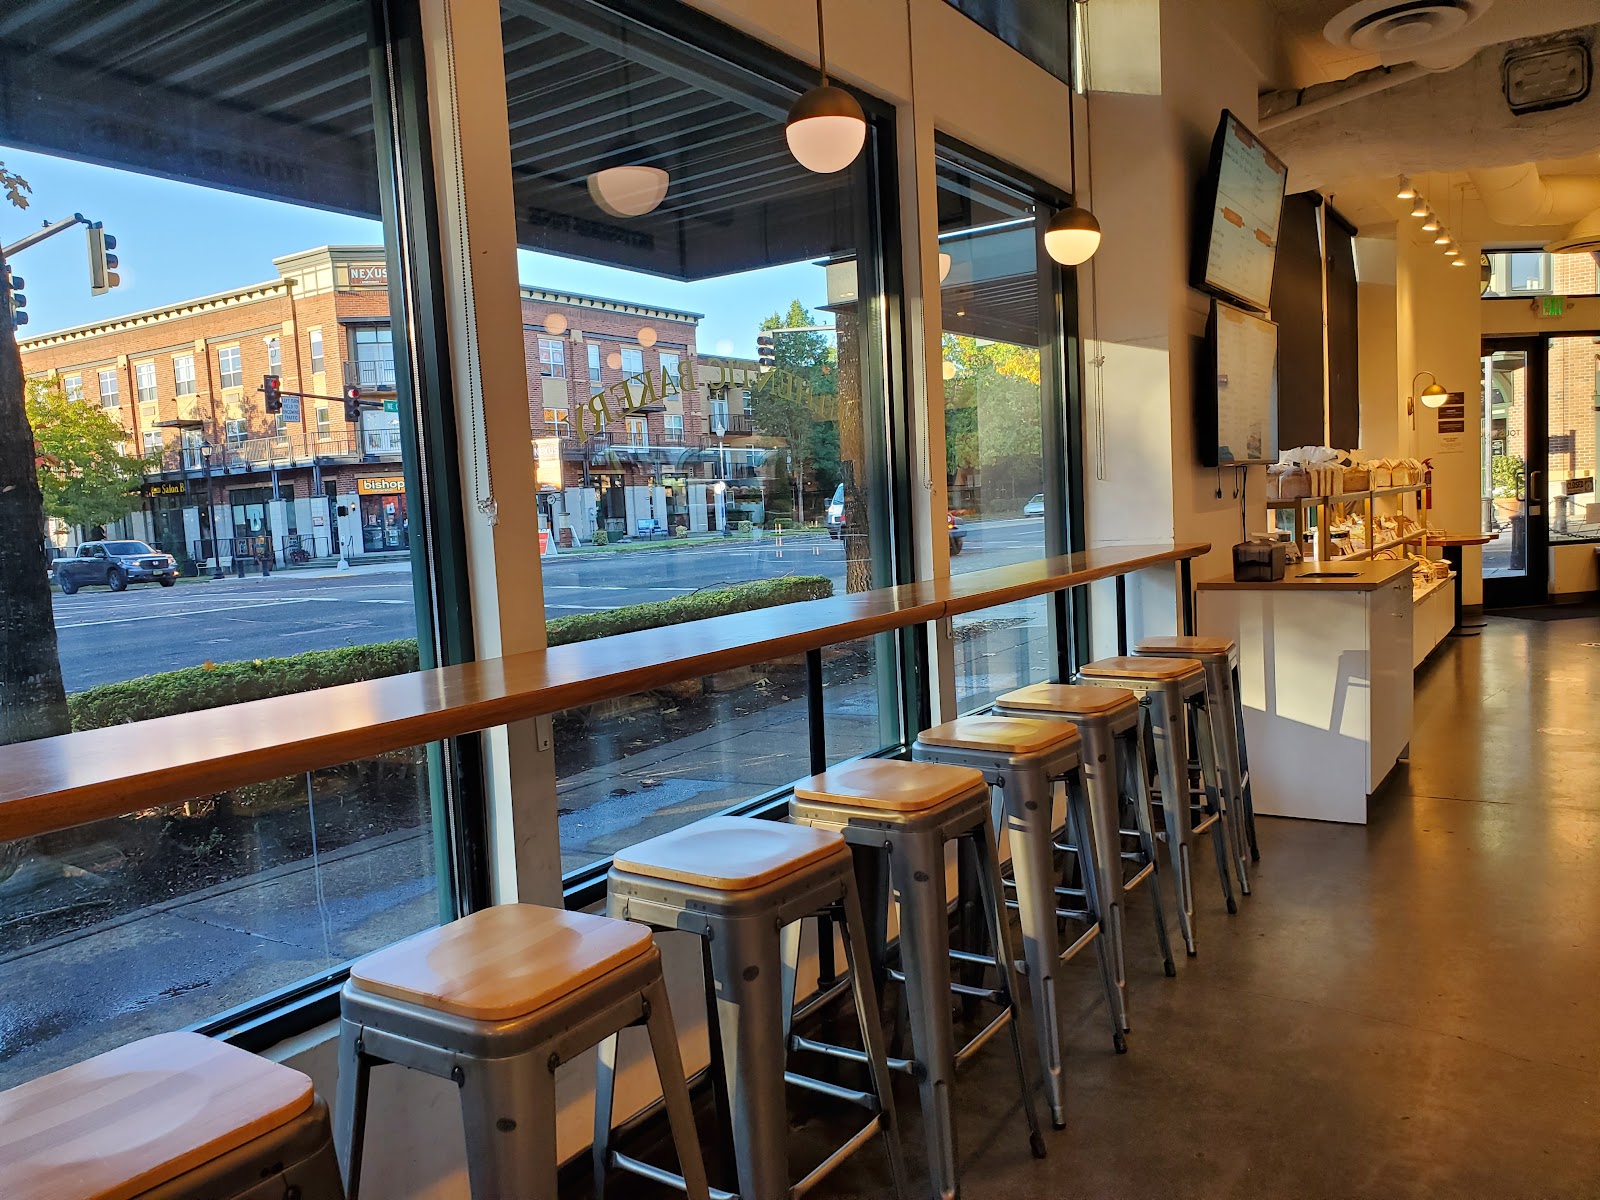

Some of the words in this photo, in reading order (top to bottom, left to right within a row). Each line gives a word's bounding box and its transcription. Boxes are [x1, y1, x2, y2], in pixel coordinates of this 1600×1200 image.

[351, 266, 387, 280] NEXUS
[162, 483, 179, 494] Salon
[1566, 480, 1584, 490] CLOSED
